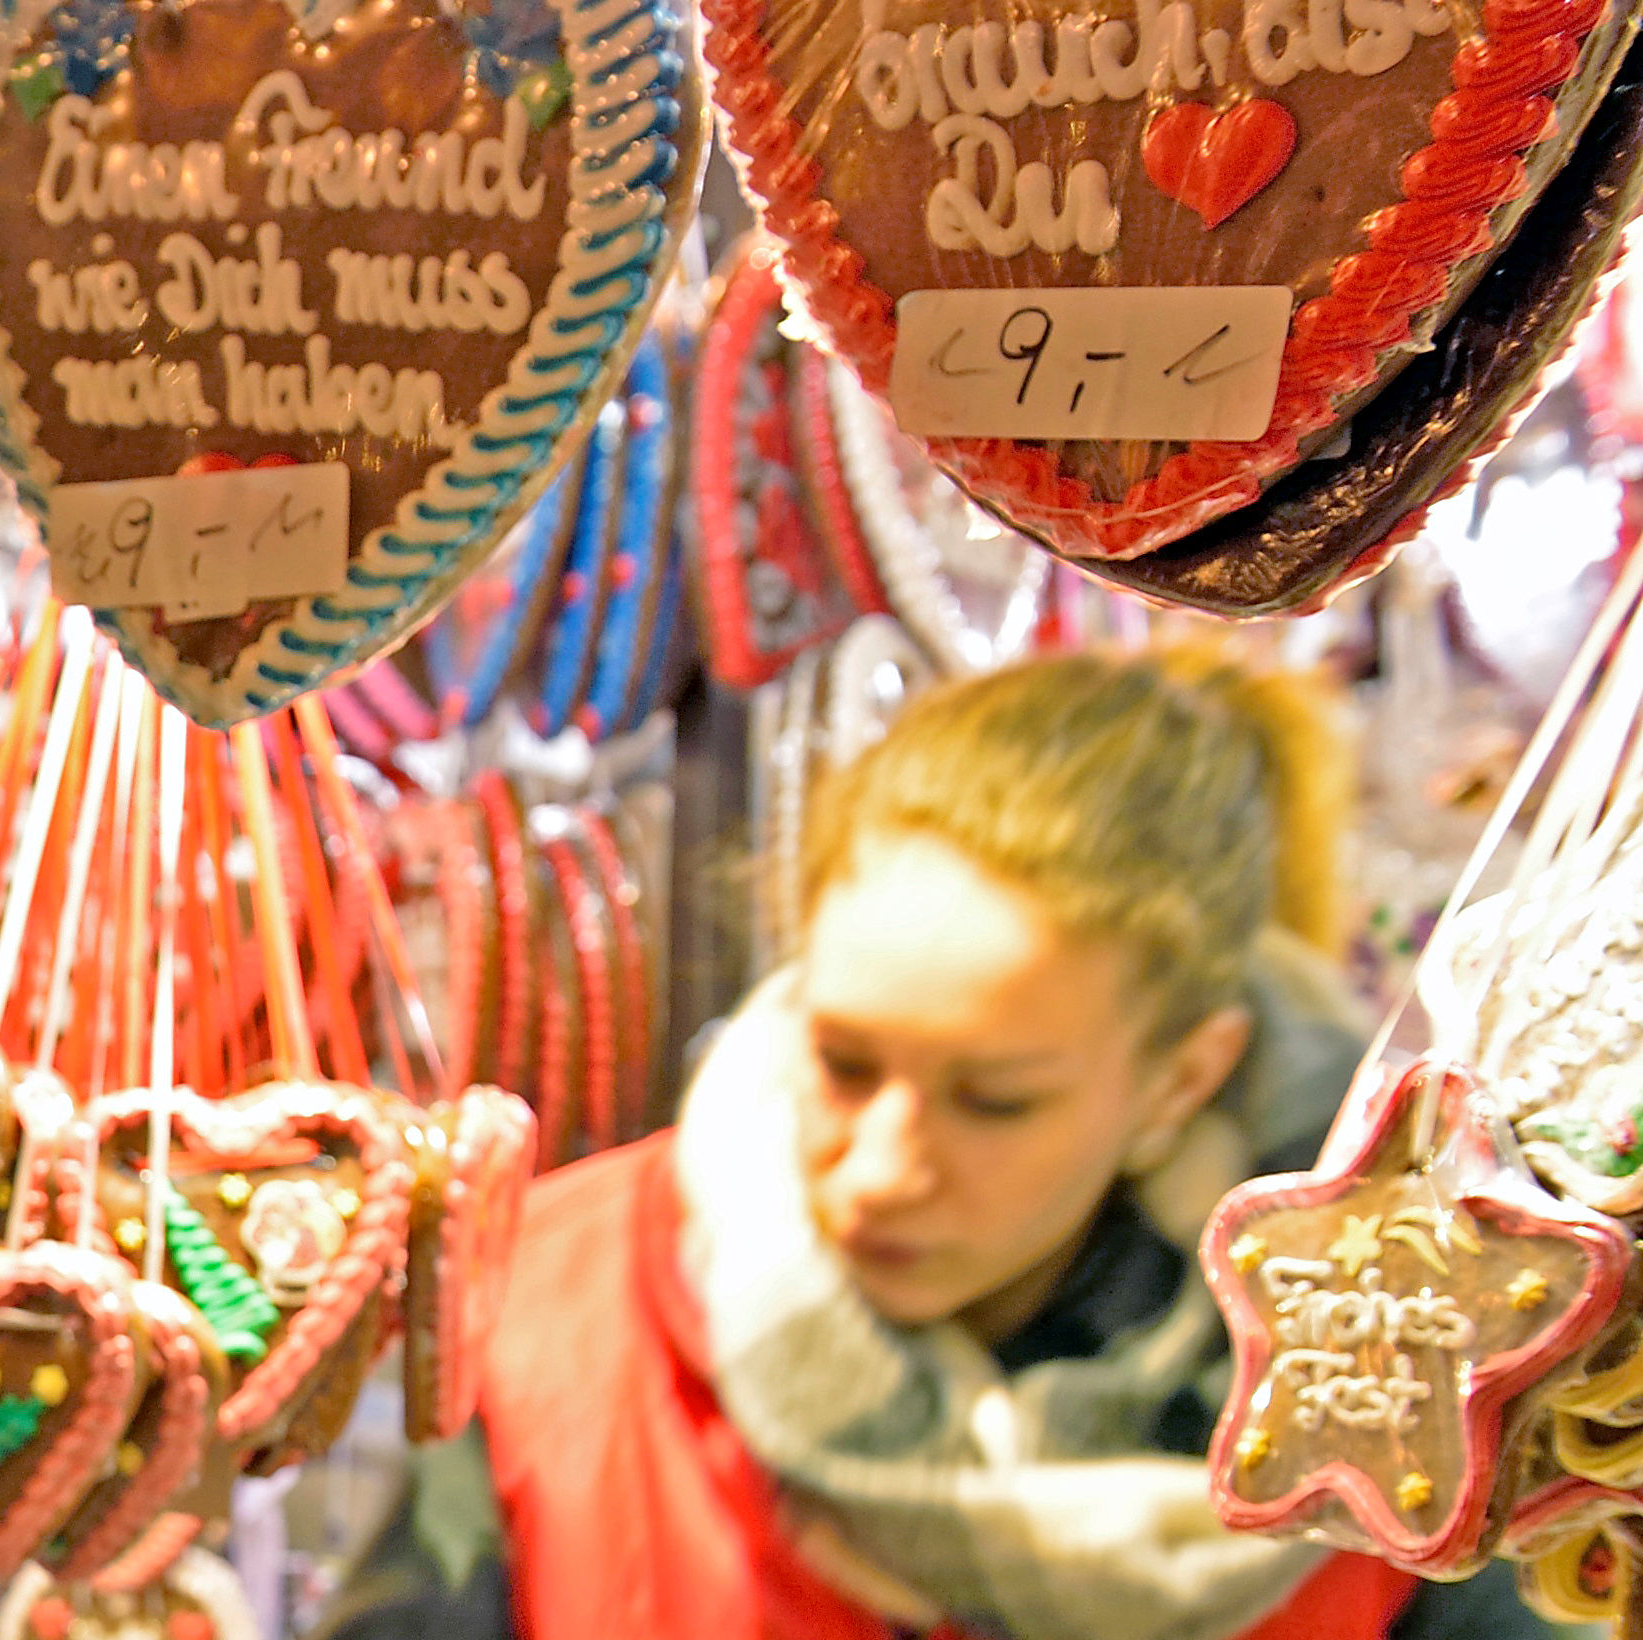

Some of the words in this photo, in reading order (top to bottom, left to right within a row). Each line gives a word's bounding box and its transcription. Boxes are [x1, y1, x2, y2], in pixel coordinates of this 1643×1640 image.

[35, 94, 239, 224] Einen
[233, 70, 547, 221] Freund
[926, 112, 1121, 257] Du
[26, 232, 143, 333] wie
[155, 222, 317, 334] Dich
[326, 247, 535, 335] muss
[51, 356, 220, 430] man
[218, 334, 465, 448] haben
